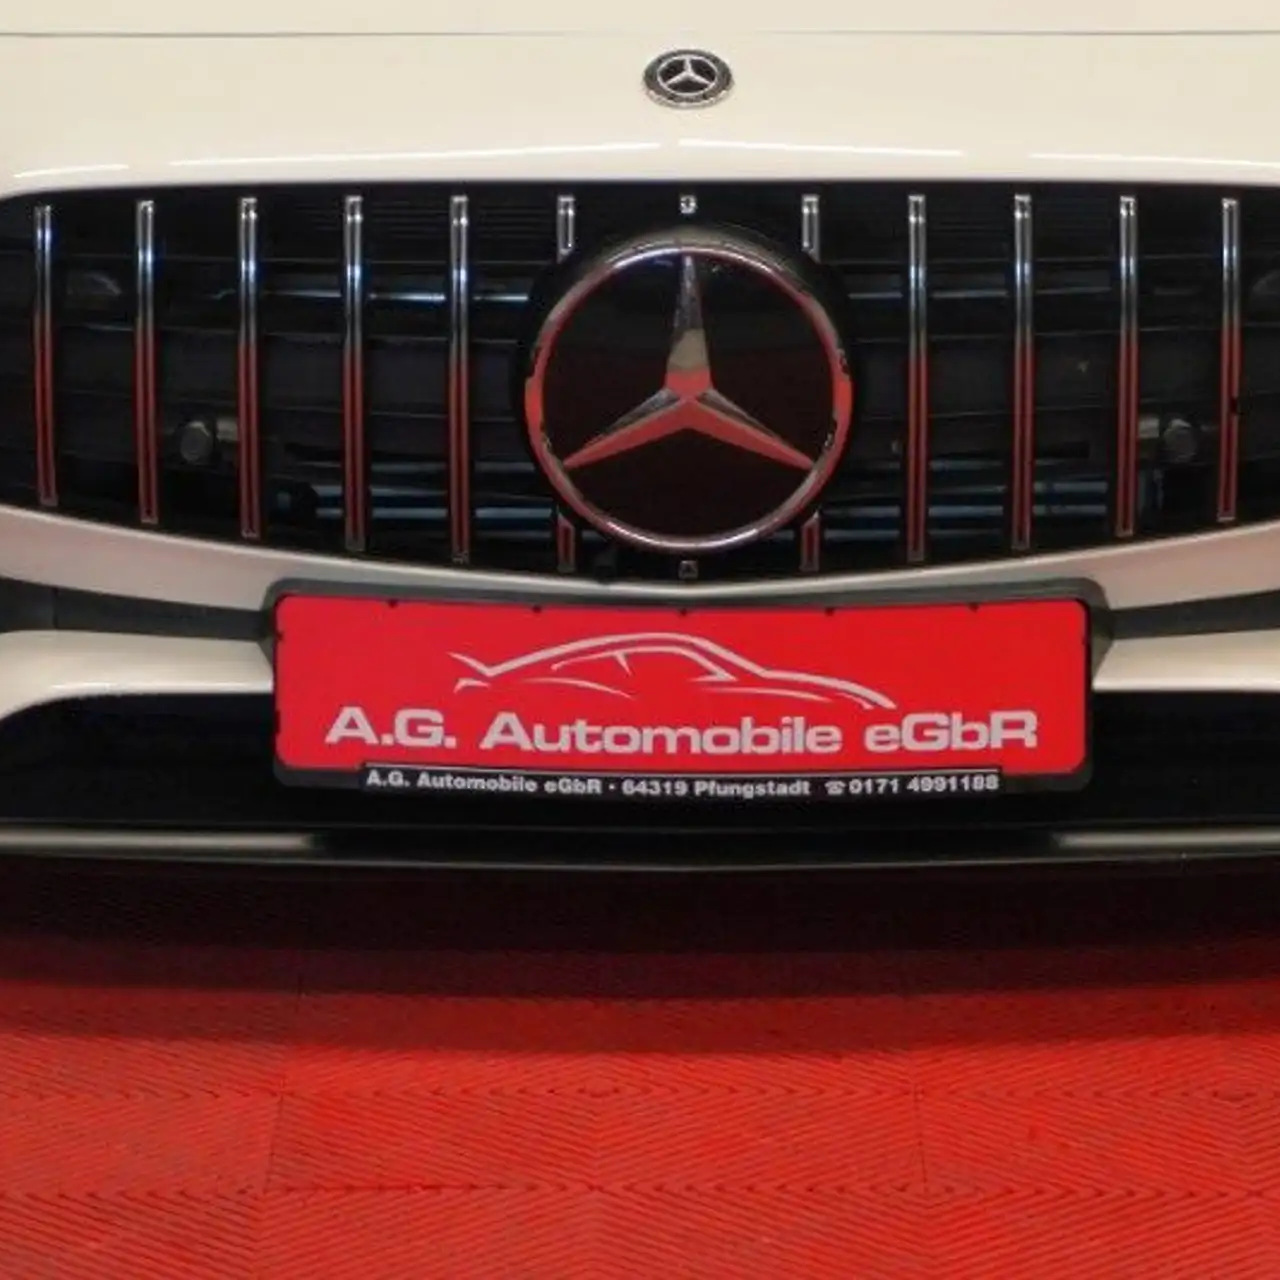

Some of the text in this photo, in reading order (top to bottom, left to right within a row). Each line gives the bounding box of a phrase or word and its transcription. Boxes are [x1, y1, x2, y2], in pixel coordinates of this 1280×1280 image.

[324, 706, 1039, 755] A.G. Automobile eGbR
[366, 770, 410, 788] A.G.
[418, 772, 538, 793] Automobile
[544, 779, 603, 794] eGbR
[694, 780, 811, 799] Pfungstadt
[848, 777, 900, 795] 0171
